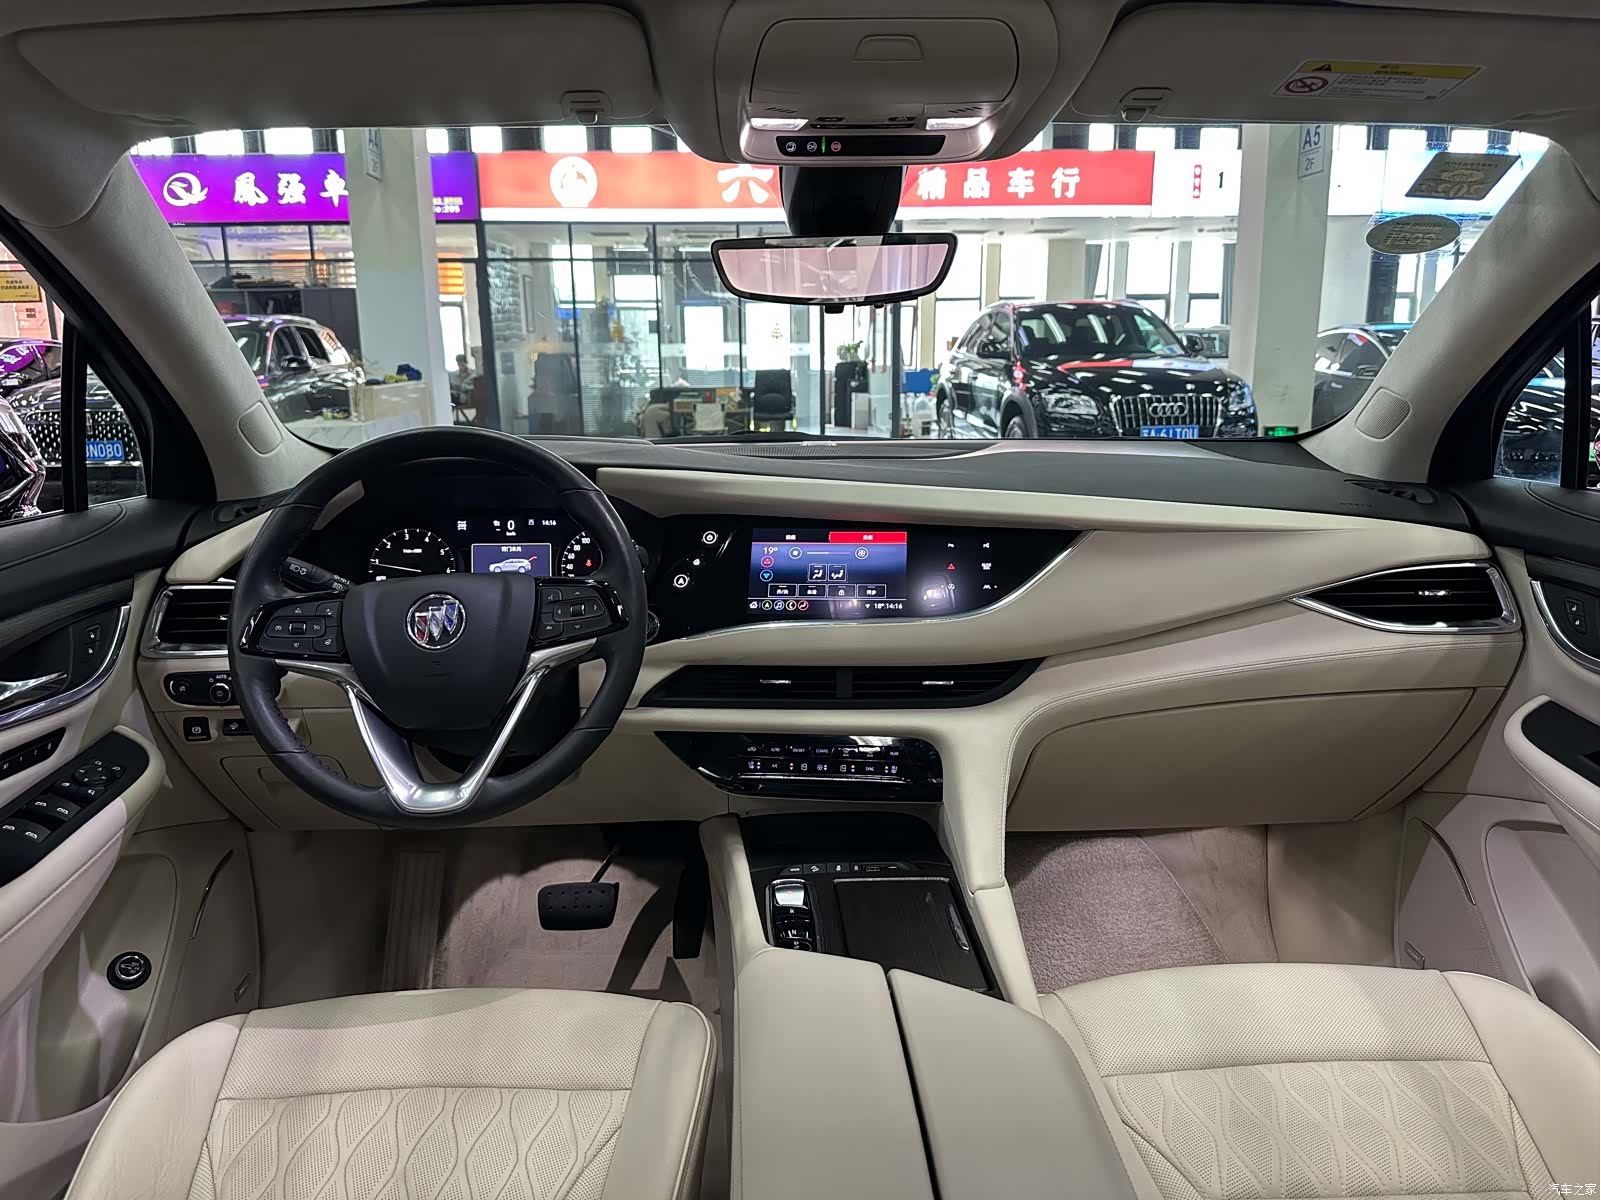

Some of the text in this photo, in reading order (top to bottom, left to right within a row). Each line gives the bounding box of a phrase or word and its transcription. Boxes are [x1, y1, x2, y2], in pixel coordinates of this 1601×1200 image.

[1302, 124, 1321, 150] A5
[1305, 157, 1315, 171] 2F
[717, 163, 1081, 204] 六 精品车行
[507, 519, 515, 531] 0
[404, 533, 409, 541] 3
[386, 541, 391, 549] 2
[440, 548, 445, 556] 5
[567, 552, 575, 560] 60
[800, 763, 808, 771] 19
[839, 764, 847, 772] 19
